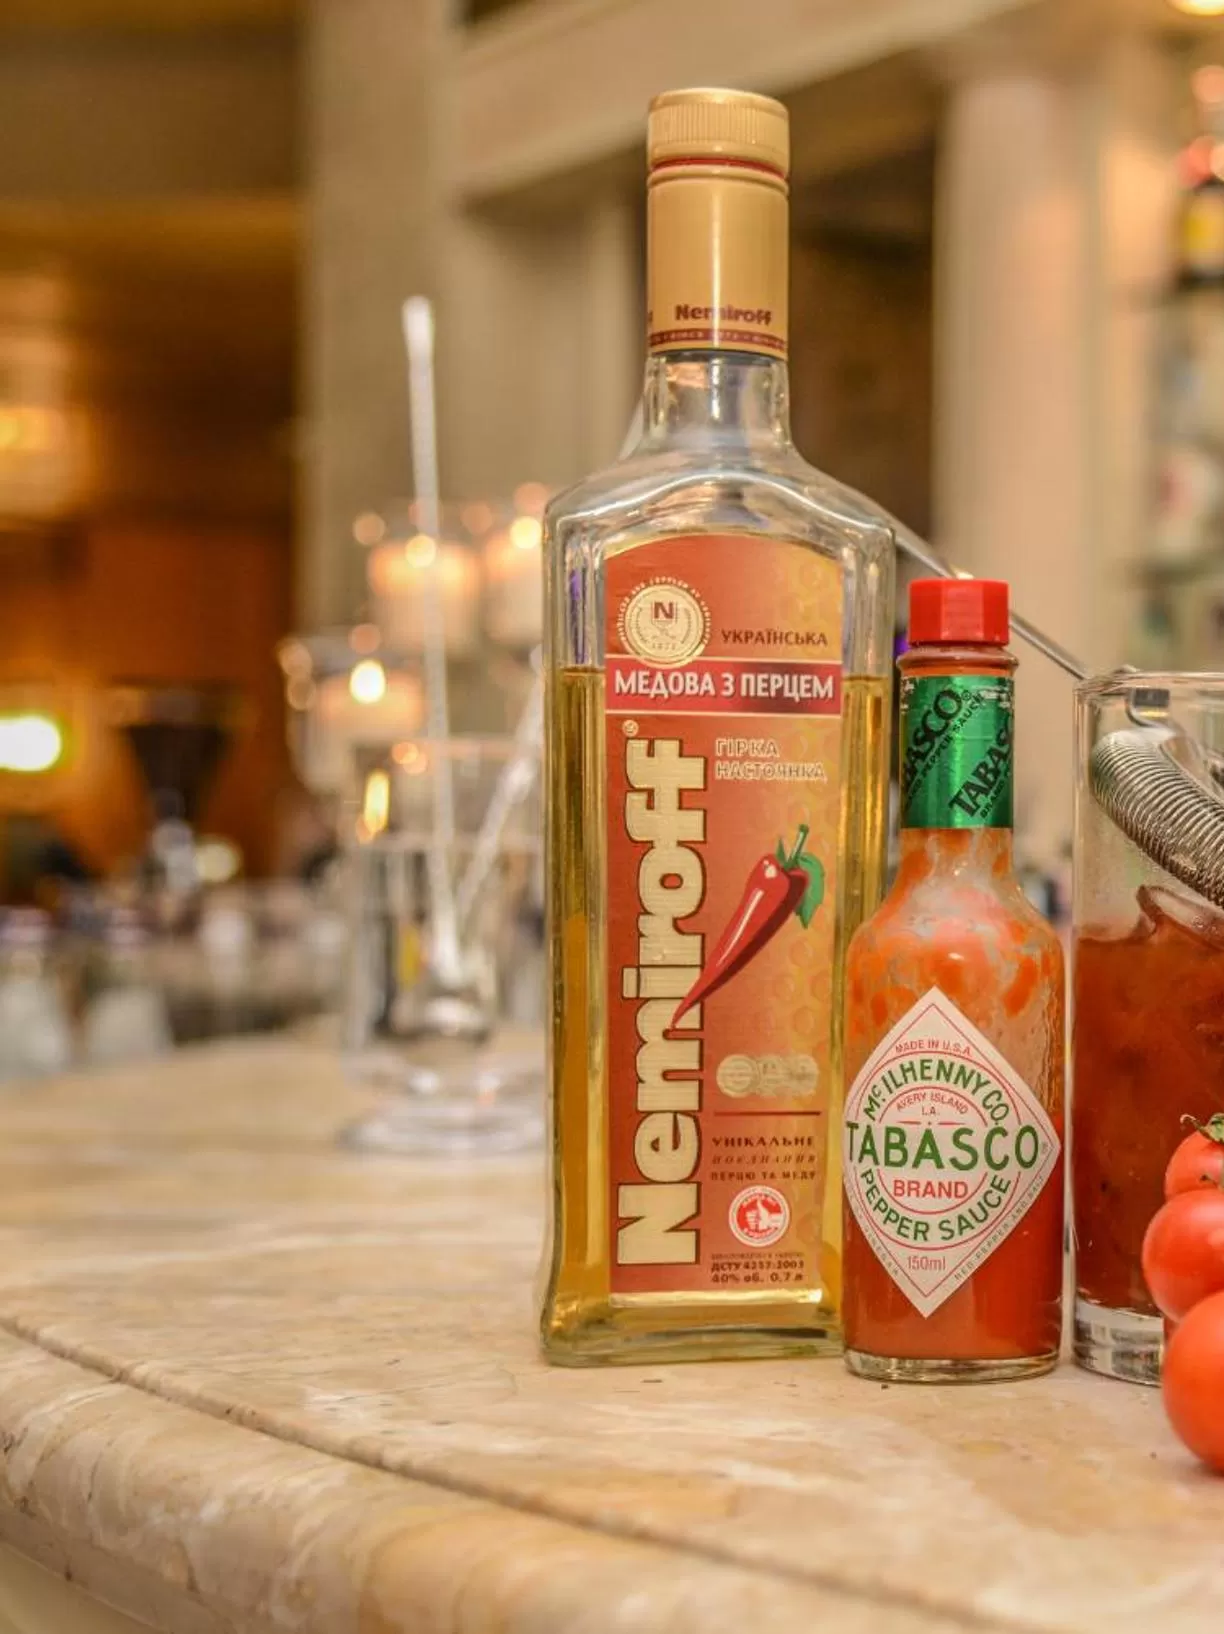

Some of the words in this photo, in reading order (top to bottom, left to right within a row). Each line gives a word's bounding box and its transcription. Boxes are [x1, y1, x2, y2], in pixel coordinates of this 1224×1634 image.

[721, 629, 828, 646] УКРАЇНСЬКА
[615, 670, 715, 698] МЕДОВА
[740, 672, 834, 702] ПЕРЦЕМ
[715, 738, 780, 757] ГІРКА
[616, 737, 707, 1265] Nemiroff
[895, 1040, 924, 1054] MADE
[927, 1039, 939, 1050] IN
[930, 1092, 969, 1115] ISLAND
[846, 1120, 1039, 1171] TABASCO
[893, 1180, 969, 1199] BRAND
[860, 1168, 930, 1242] PEPPER
[939, 1175, 1011, 1242] SAUCE
[906, 1255, 946, 1270] 150ml
